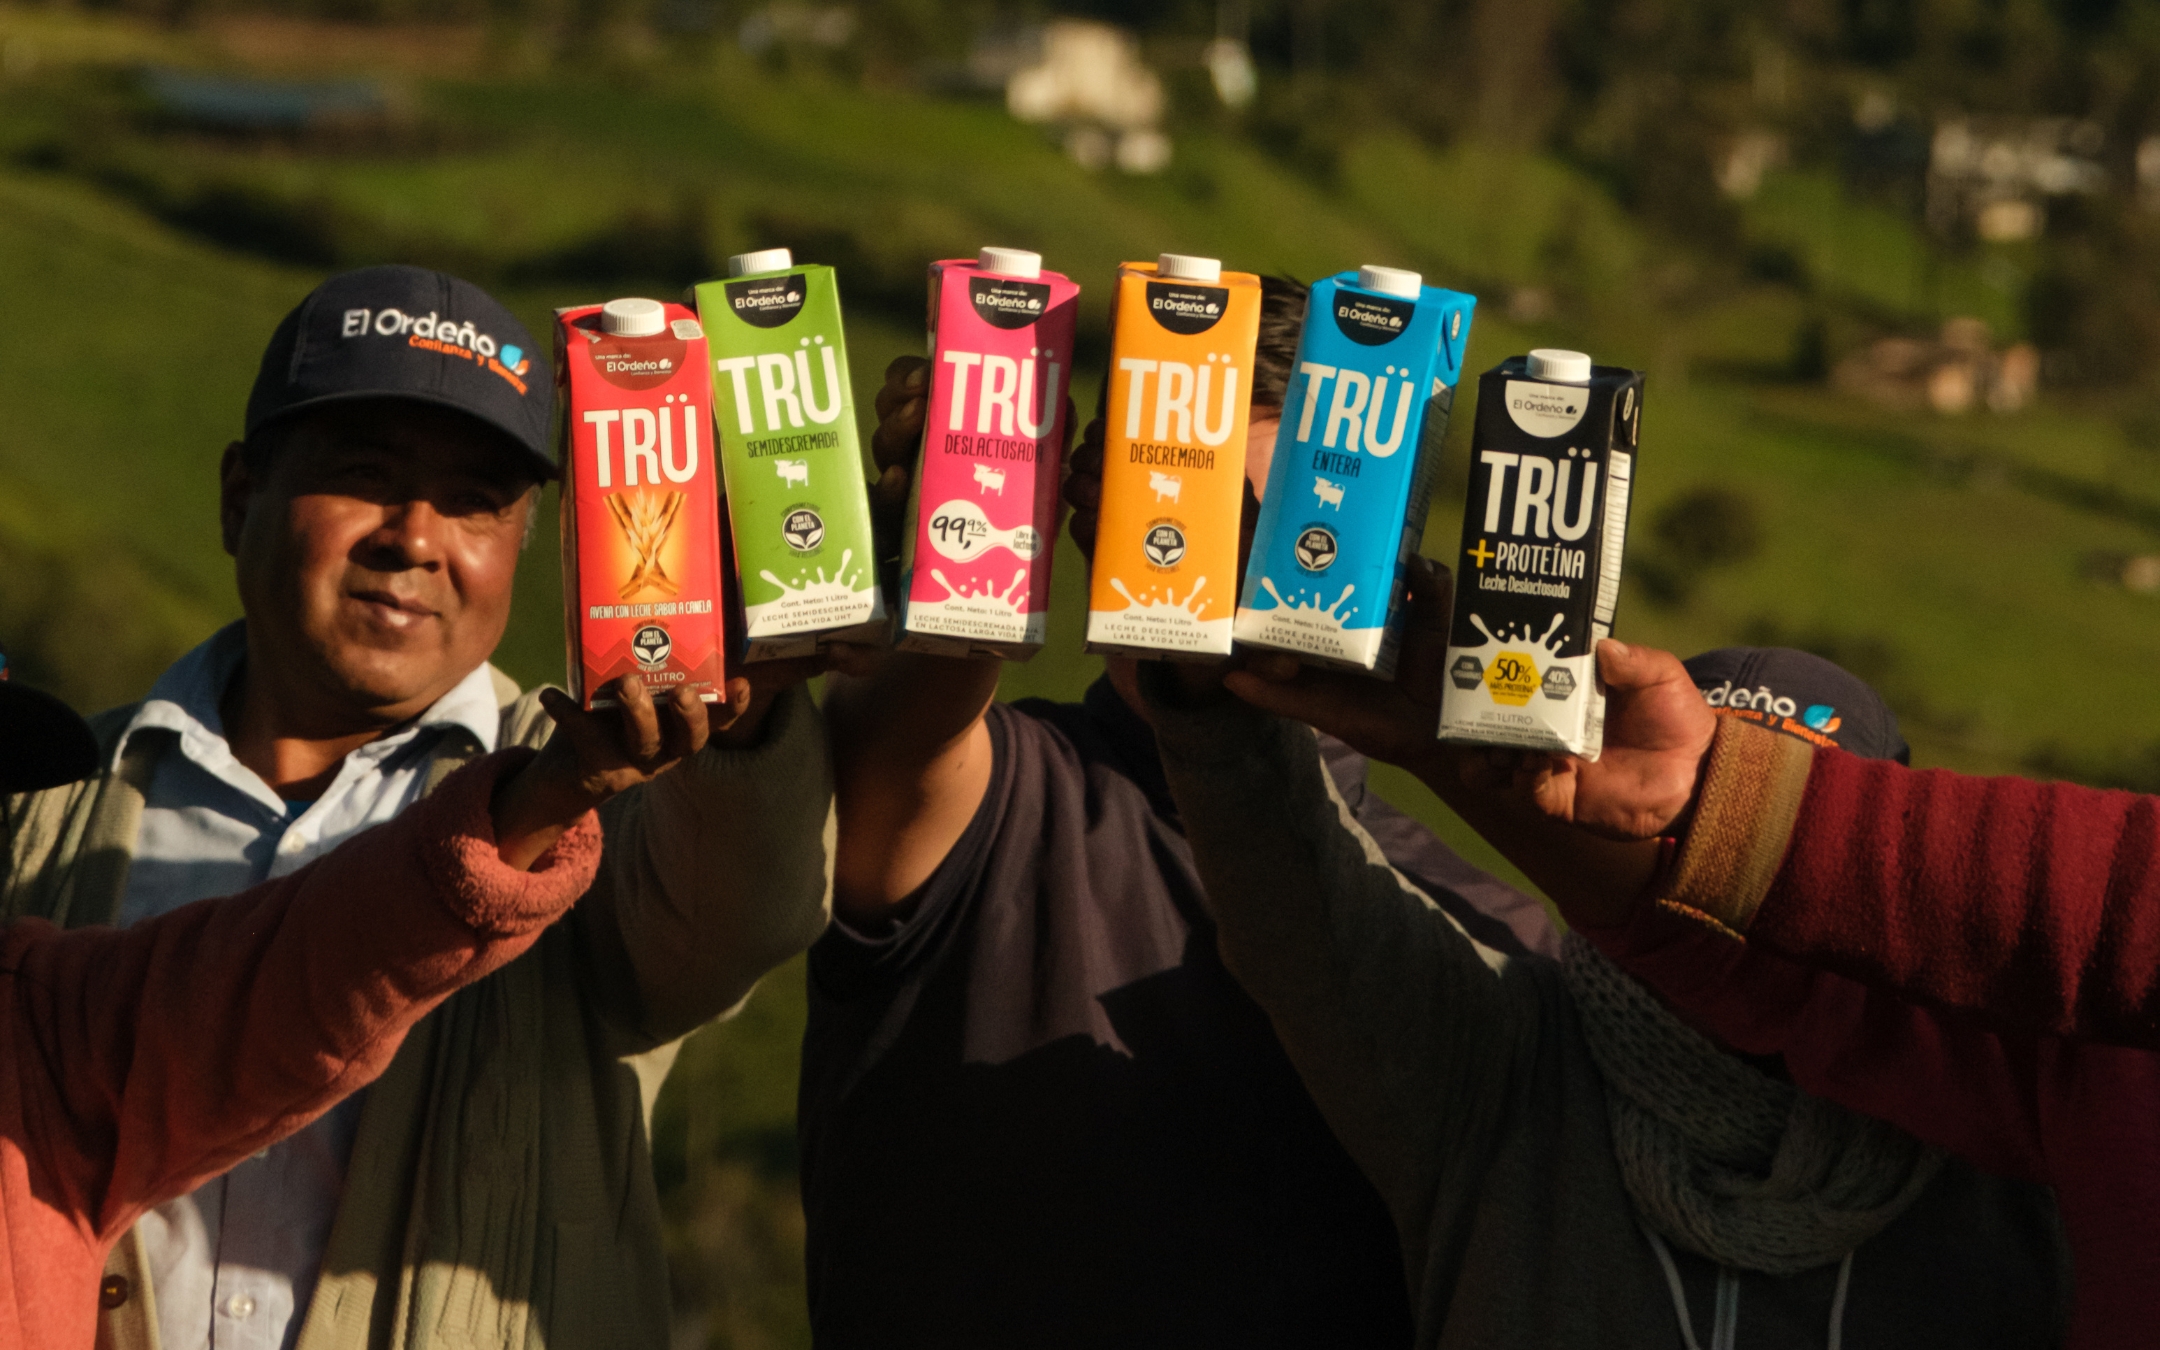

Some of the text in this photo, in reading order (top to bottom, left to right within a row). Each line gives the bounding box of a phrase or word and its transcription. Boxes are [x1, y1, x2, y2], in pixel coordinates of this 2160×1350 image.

[735, 294, 785, 309] El Ordeño
[975, 293, 1026, 309] El Ordeño
[1153, 298, 1204, 313] El Ordeño
[1339, 306, 1388, 326] El Ordeño
[342, 307, 496, 357] El Ordeño
[607, 361, 657, 372] El Ordeño
[717, 335, 842, 435] TRÜ
[943, 347, 1060, 439] TRÜ
[1119, 352, 1238, 446] TRÜ
[1513, 400, 1563, 414] El Ordeño
[1297, 361, 1414, 458] TRÜ
[583, 393, 698, 488] TRÜ
[747, 431, 840, 458] SEMIDESCREMADA
[944, 434, 1044, 463] DESLACTOSADA
[1130, 443, 1215, 470] DESCREMADA
[1312, 449, 1361, 478] ENTERA
[1481, 447, 1598, 541] TRÜ
[791, 522, 815, 531] PLANETA
[1153, 537, 1177, 547] PLANETA
[1479, 572, 1570, 599] Leche Deslactosada
[590, 599, 712, 619] AVENA CON LECHE SABOR A CANELA
[762, 603, 869, 622] LECHE SEMIDESCREMADA
[995, 609, 1012, 617] Litro
[782, 613, 852, 628] LARGA VIDA UHT
[914, 615, 940, 623] LECHE
[943, 618, 1016, 632] SEMIDESCREMADA
[1174, 618, 1192, 626] Litro
[929, 624, 966, 633] LACTOSA
[969, 627, 995, 637] LARGA
[998, 631, 1017, 639] VIDA
[1104, 624, 1209, 639] LECHE DESCREMADA
[1113, 633, 1146, 642] LARGA
[1151, 636, 1174, 644] VIDA
[1265, 626, 1341, 646] LECHE ENTERA
[640, 637, 663, 646] PLANETA
[1259, 633, 1345, 655] LARGA VIDA UHT
[646, 672, 685, 682] 1 LITRO
[1495, 658, 1532, 683] 50%
[1703, 680, 1797, 717] deño
[1502, 714, 1533, 725] LITRO
